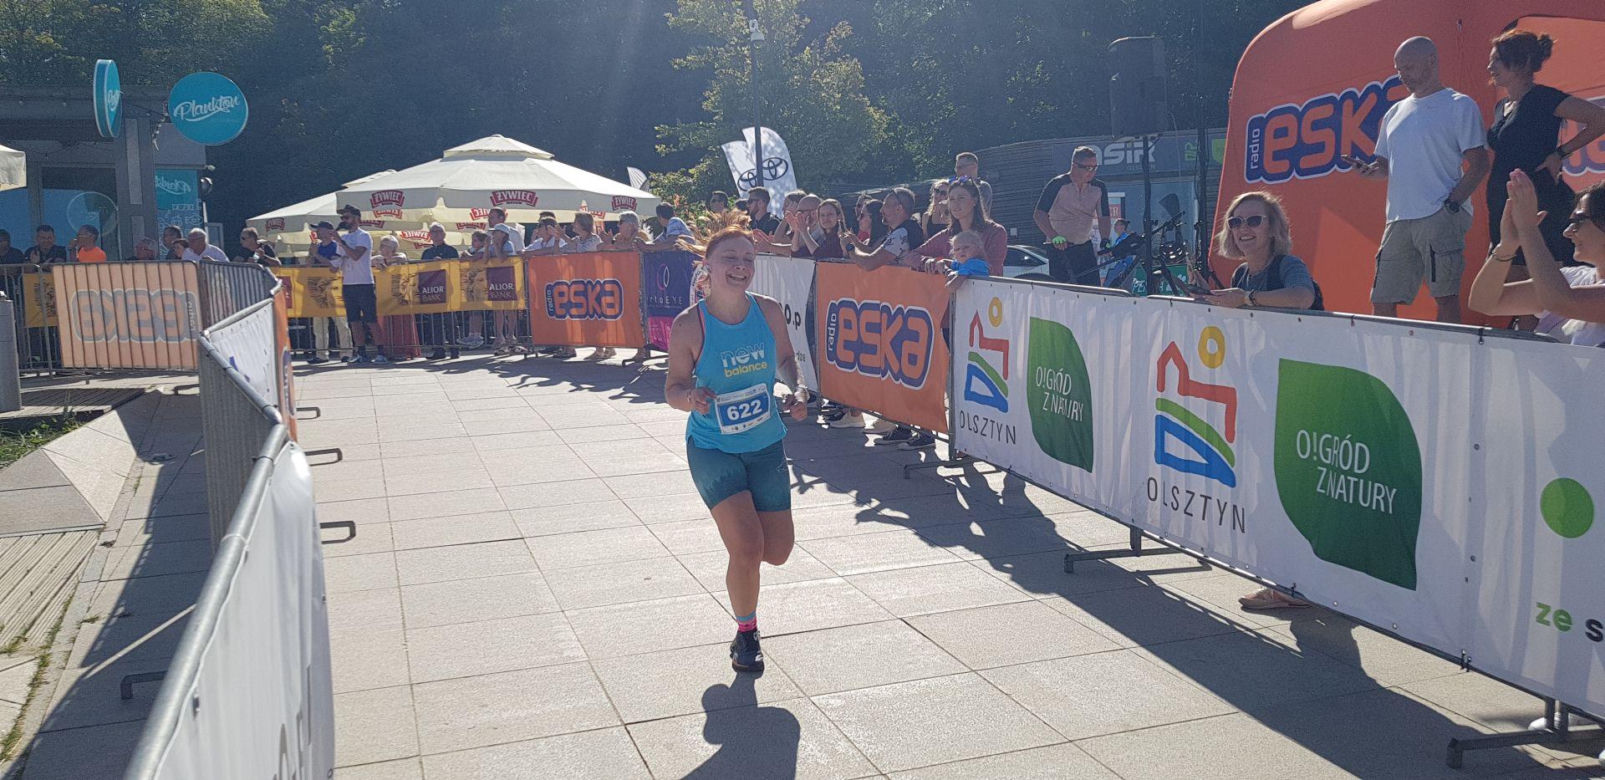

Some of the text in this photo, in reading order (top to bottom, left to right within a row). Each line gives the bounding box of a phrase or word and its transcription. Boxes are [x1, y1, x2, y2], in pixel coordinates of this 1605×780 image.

[174, 96, 240, 122] Plankton
[1249, 128, 1261, 169] radio
[422, 286, 444, 294] ALIOR
[489, 283, 514, 291] ALIOR
[553, 284, 620, 316] eska
[720, 343, 765, 367] new
[828, 307, 929, 379] radio eska
[724, 361, 769, 378] balance
[726, 399, 762, 420] 622
[959, 410, 1017, 445] OLSZTYN
[1295, 429, 1371, 474] O!GRÓD
[1146, 476, 1246, 534] OLSZTYN
[1535, 601, 1574, 632] ze
